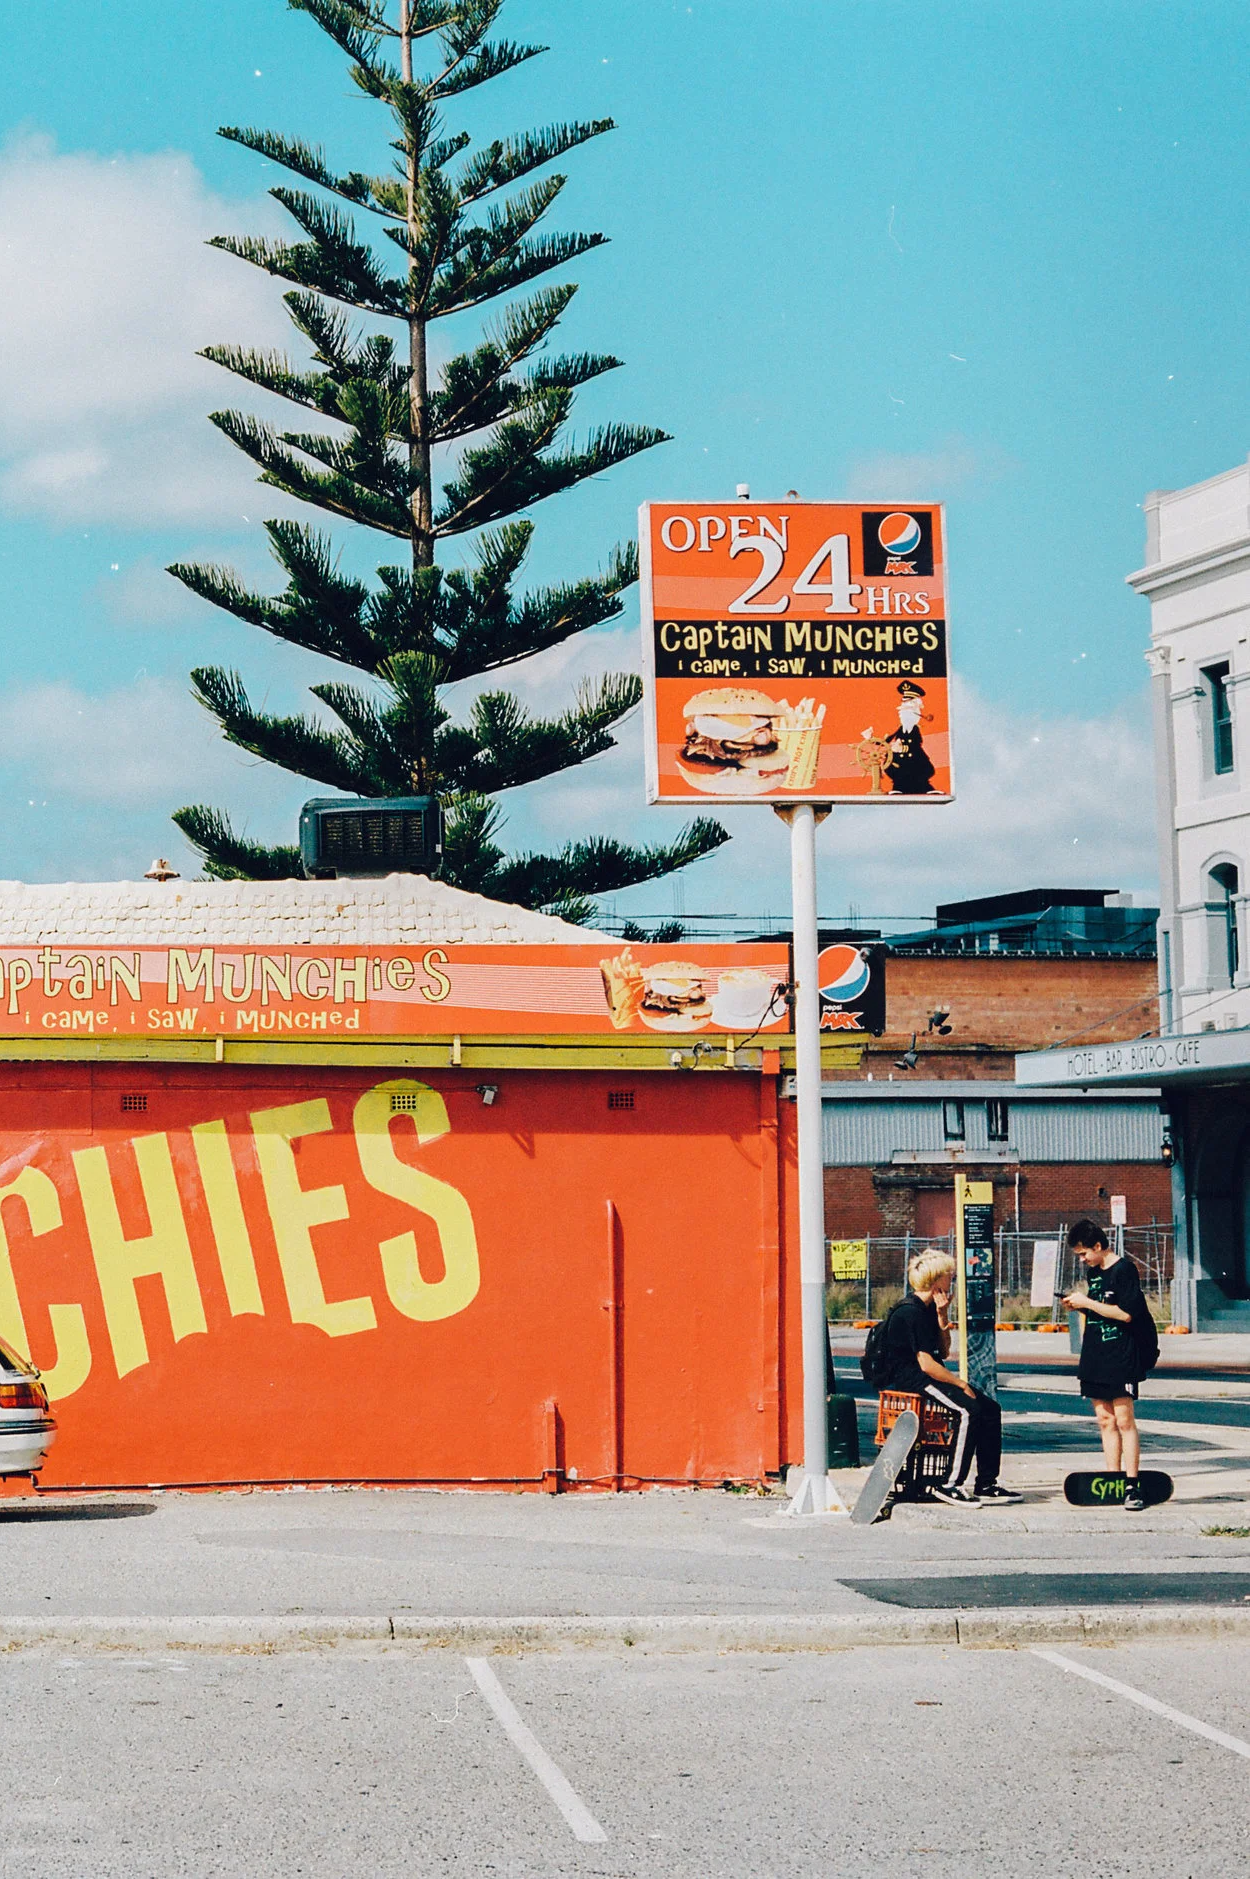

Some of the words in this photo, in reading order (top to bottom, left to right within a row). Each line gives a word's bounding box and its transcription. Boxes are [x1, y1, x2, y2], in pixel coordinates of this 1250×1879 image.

[661, 515, 790, 553] OPEN
[728, 533, 862, 614] 24
[865, 586, 931, 615] HRS
[25, 1012, 31, 1025] i
[130, 1012, 136, 1025] i
[220, 1012, 225, 1025] i
[820, 1011, 865, 1030] MAX
[1067, 1052, 1098, 1076] HOTEL
[1106, 1049, 1123, 1073] BAR
[1131, 1045, 1167, 1070] BISTRO
